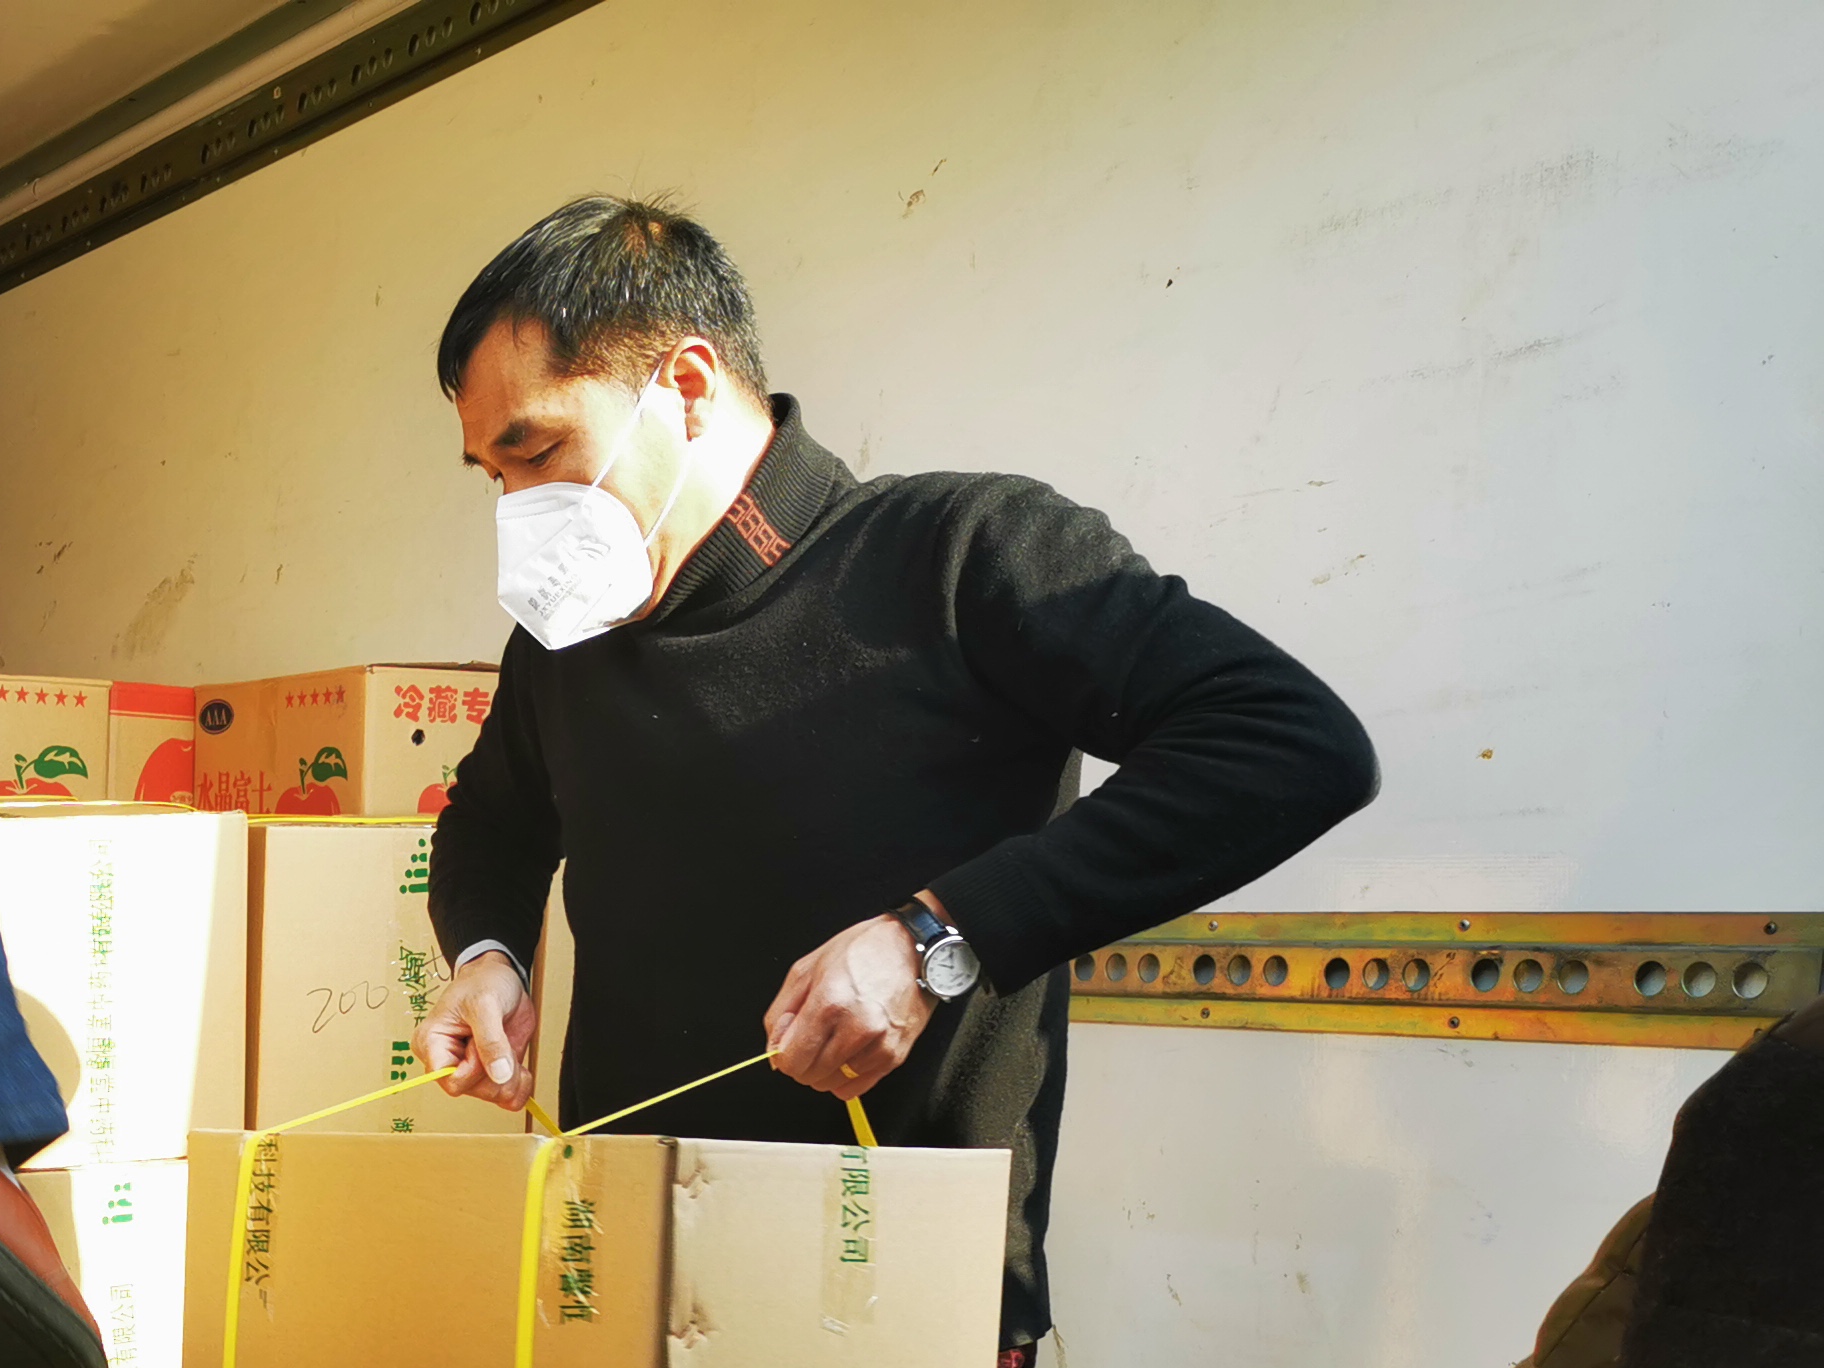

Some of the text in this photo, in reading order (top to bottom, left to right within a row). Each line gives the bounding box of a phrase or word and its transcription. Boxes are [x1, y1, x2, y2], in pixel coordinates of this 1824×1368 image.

[205, 708, 227, 727] AAA
[393, 684, 491, 726] 冷藏专
[306, 980, 390, 1034] 200
